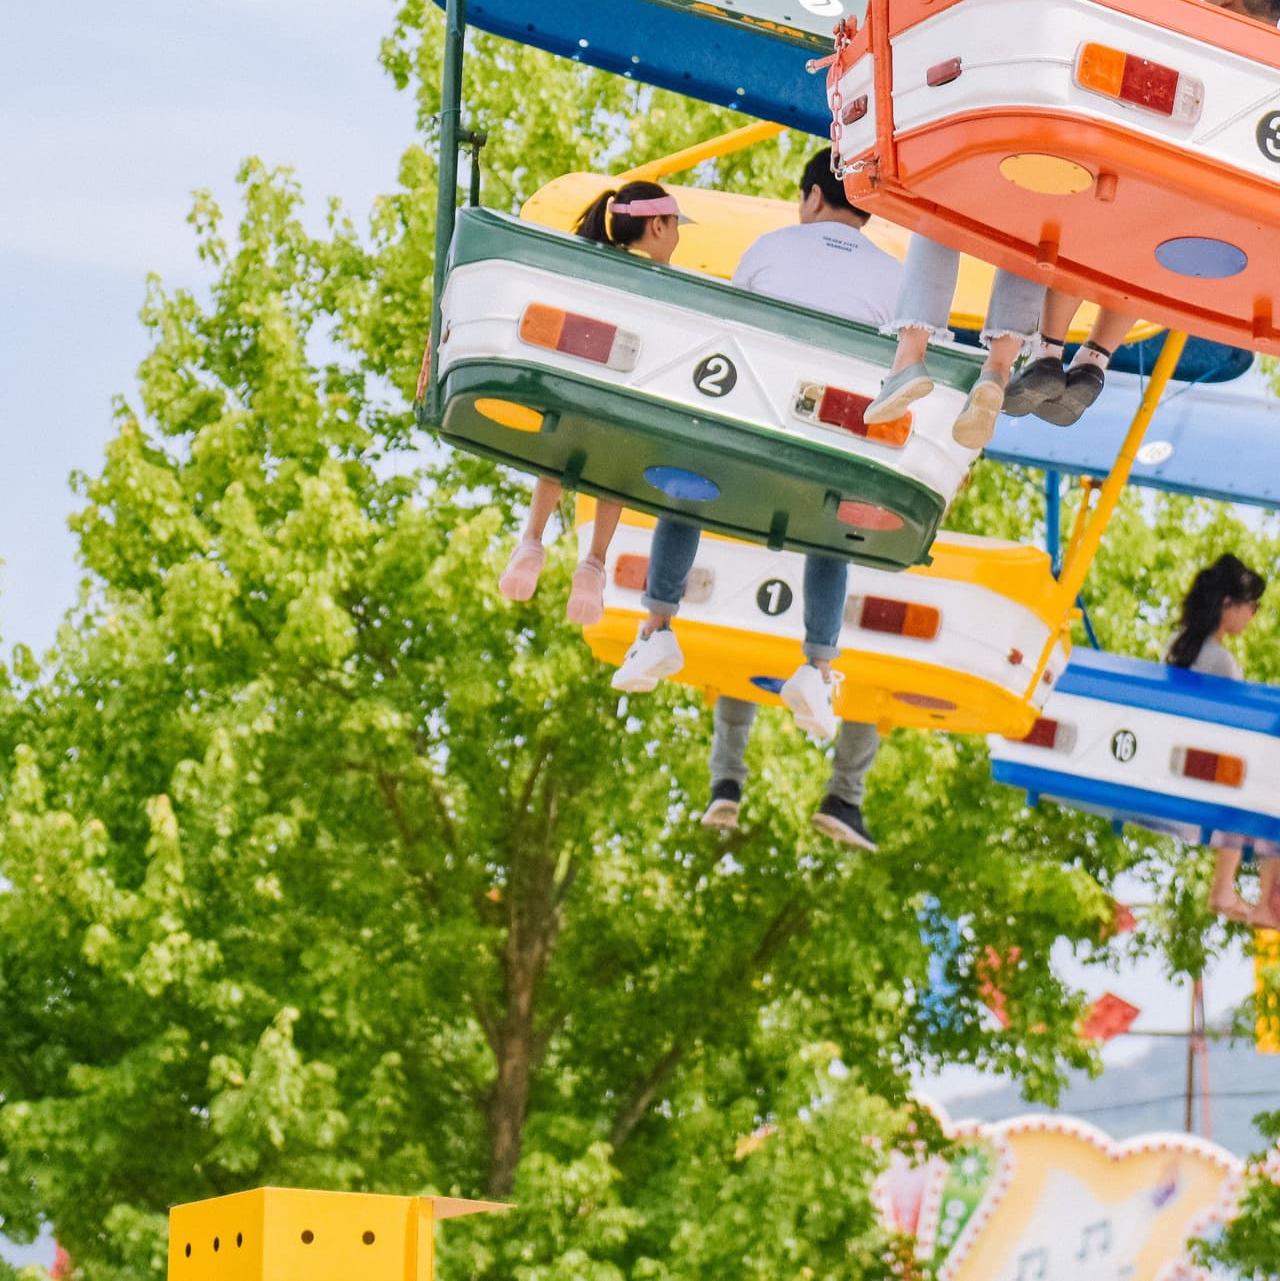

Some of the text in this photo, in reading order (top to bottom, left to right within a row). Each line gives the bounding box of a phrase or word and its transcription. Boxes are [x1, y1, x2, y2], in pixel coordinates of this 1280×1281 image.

[699, 357, 729, 395] 2
[766, 583, 781, 613] 1
[1115, 732, 1134, 760] 16
